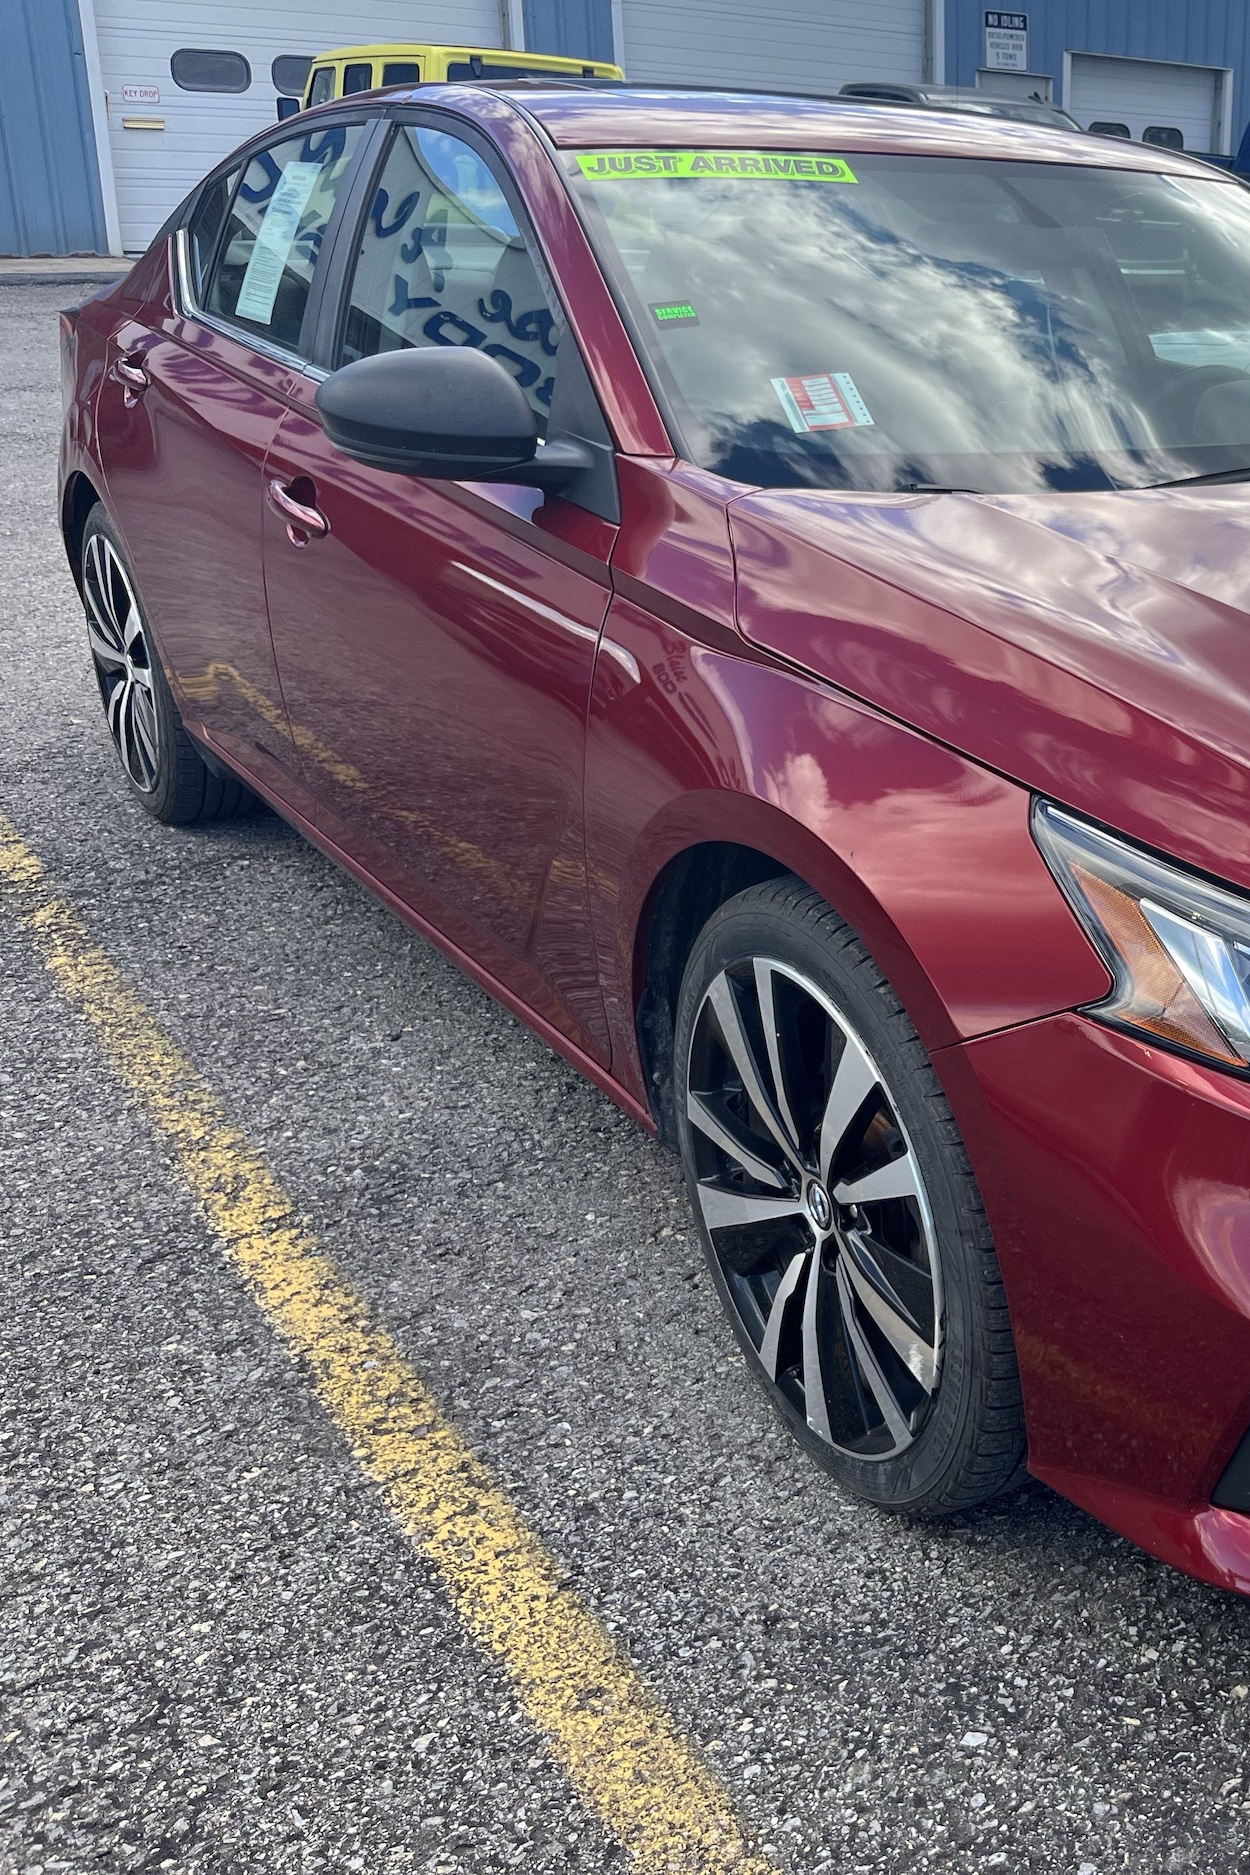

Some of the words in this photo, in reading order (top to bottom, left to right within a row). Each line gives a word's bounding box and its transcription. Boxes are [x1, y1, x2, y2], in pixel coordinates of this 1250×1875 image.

[987, 14, 999, 27] NO
[1000, 15, 1025, 29] IDLING
[1002, 52, 1017, 61] TONS
[124, 89, 138, 98] KEY
[139, 90, 158, 98] DROP
[587, 155, 684, 176] JUST
[691, 156, 846, 179] ARRIVED
[654, 304, 692, 316] SERVICE
